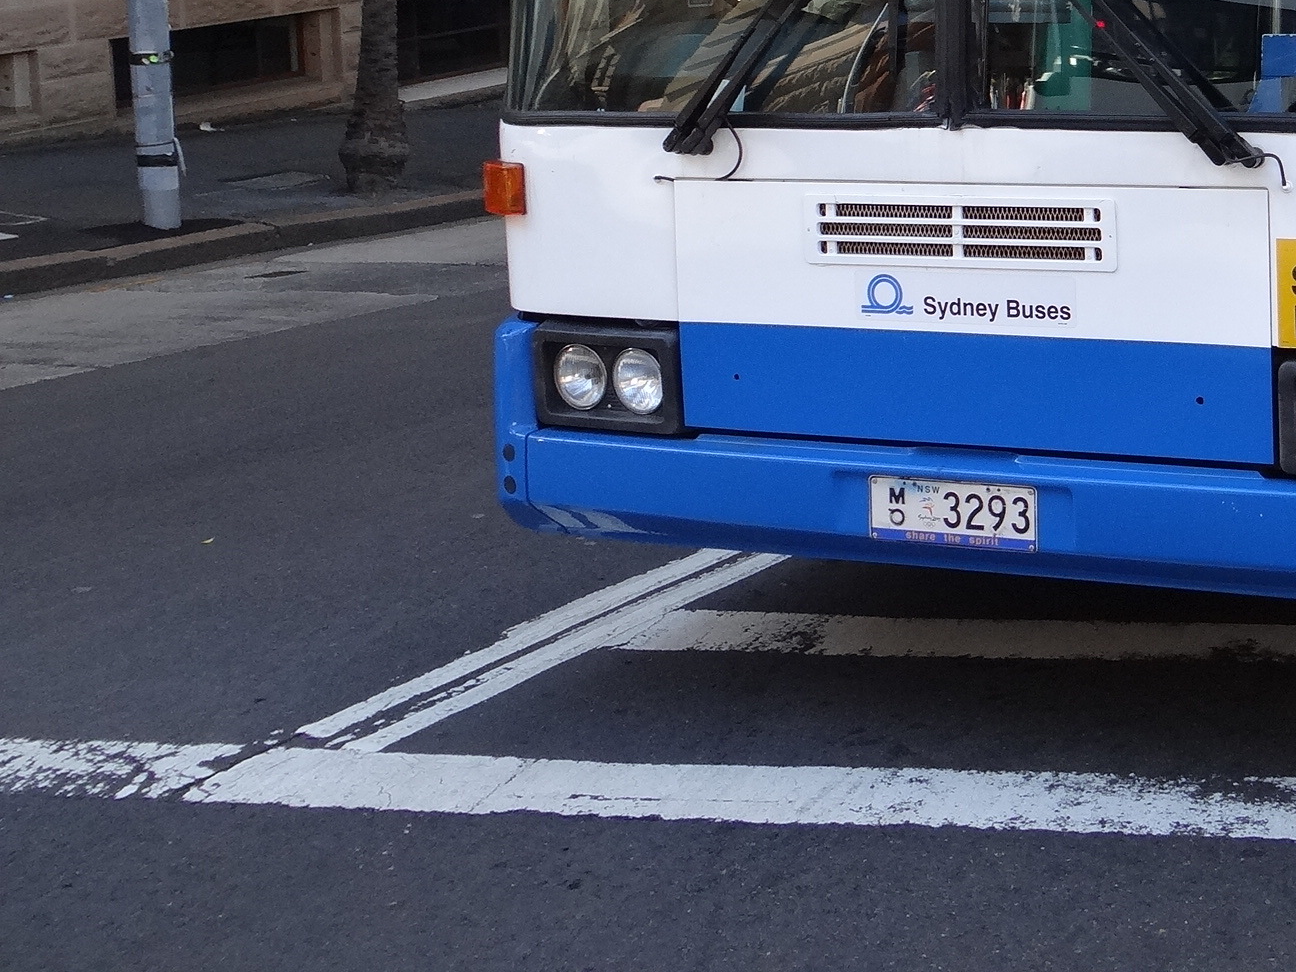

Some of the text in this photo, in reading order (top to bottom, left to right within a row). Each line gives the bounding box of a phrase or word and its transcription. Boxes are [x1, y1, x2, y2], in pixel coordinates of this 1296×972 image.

[923, 295, 1072, 322] Sydney Buses
[917, 485, 940, 494] NSW
[943, 491, 1031, 535] 3293
[905, 530, 999, 547] share the spirit
